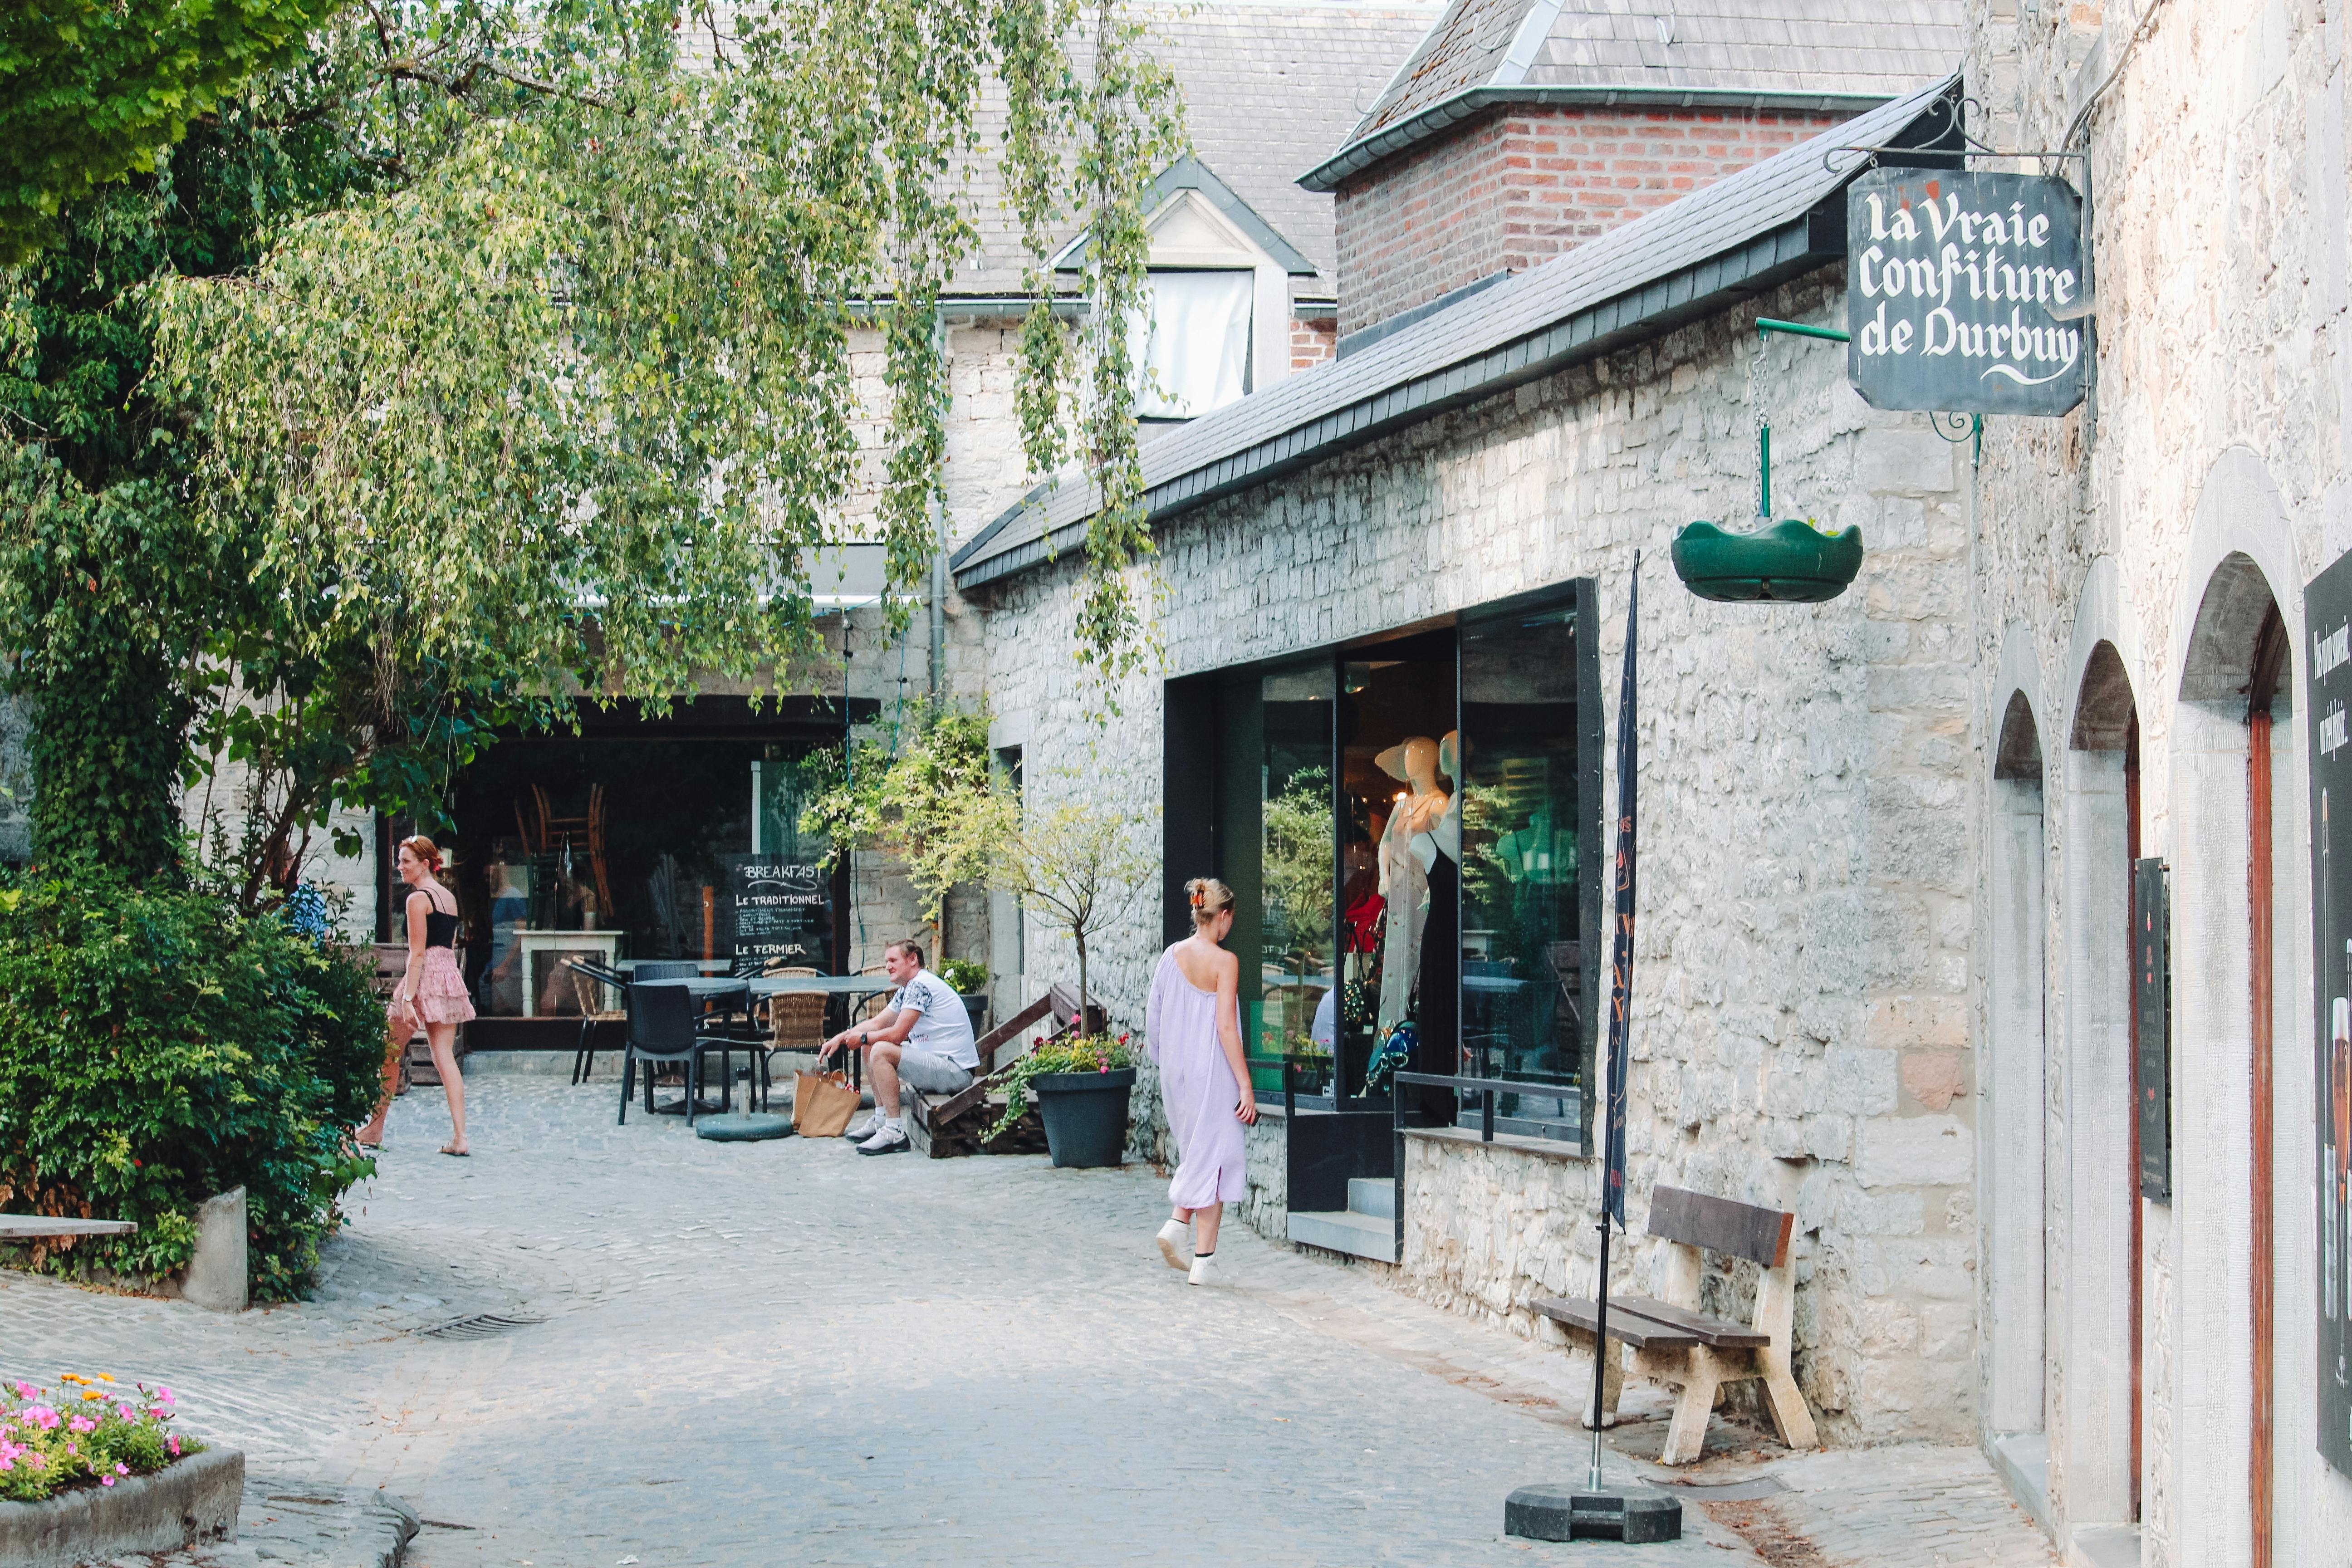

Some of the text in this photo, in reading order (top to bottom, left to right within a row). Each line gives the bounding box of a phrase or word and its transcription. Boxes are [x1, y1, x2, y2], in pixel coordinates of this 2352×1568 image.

[1917, 191, 2050, 248] Vraie
[1859, 241, 2075, 307] Confiture
[1860, 300, 2078, 386] de Durbuy
[744, 865, 821, 879] BREAKFAST
[751, 894, 824, 906] TRADITIONNEL
[753, 943, 807, 955] FERMIER
